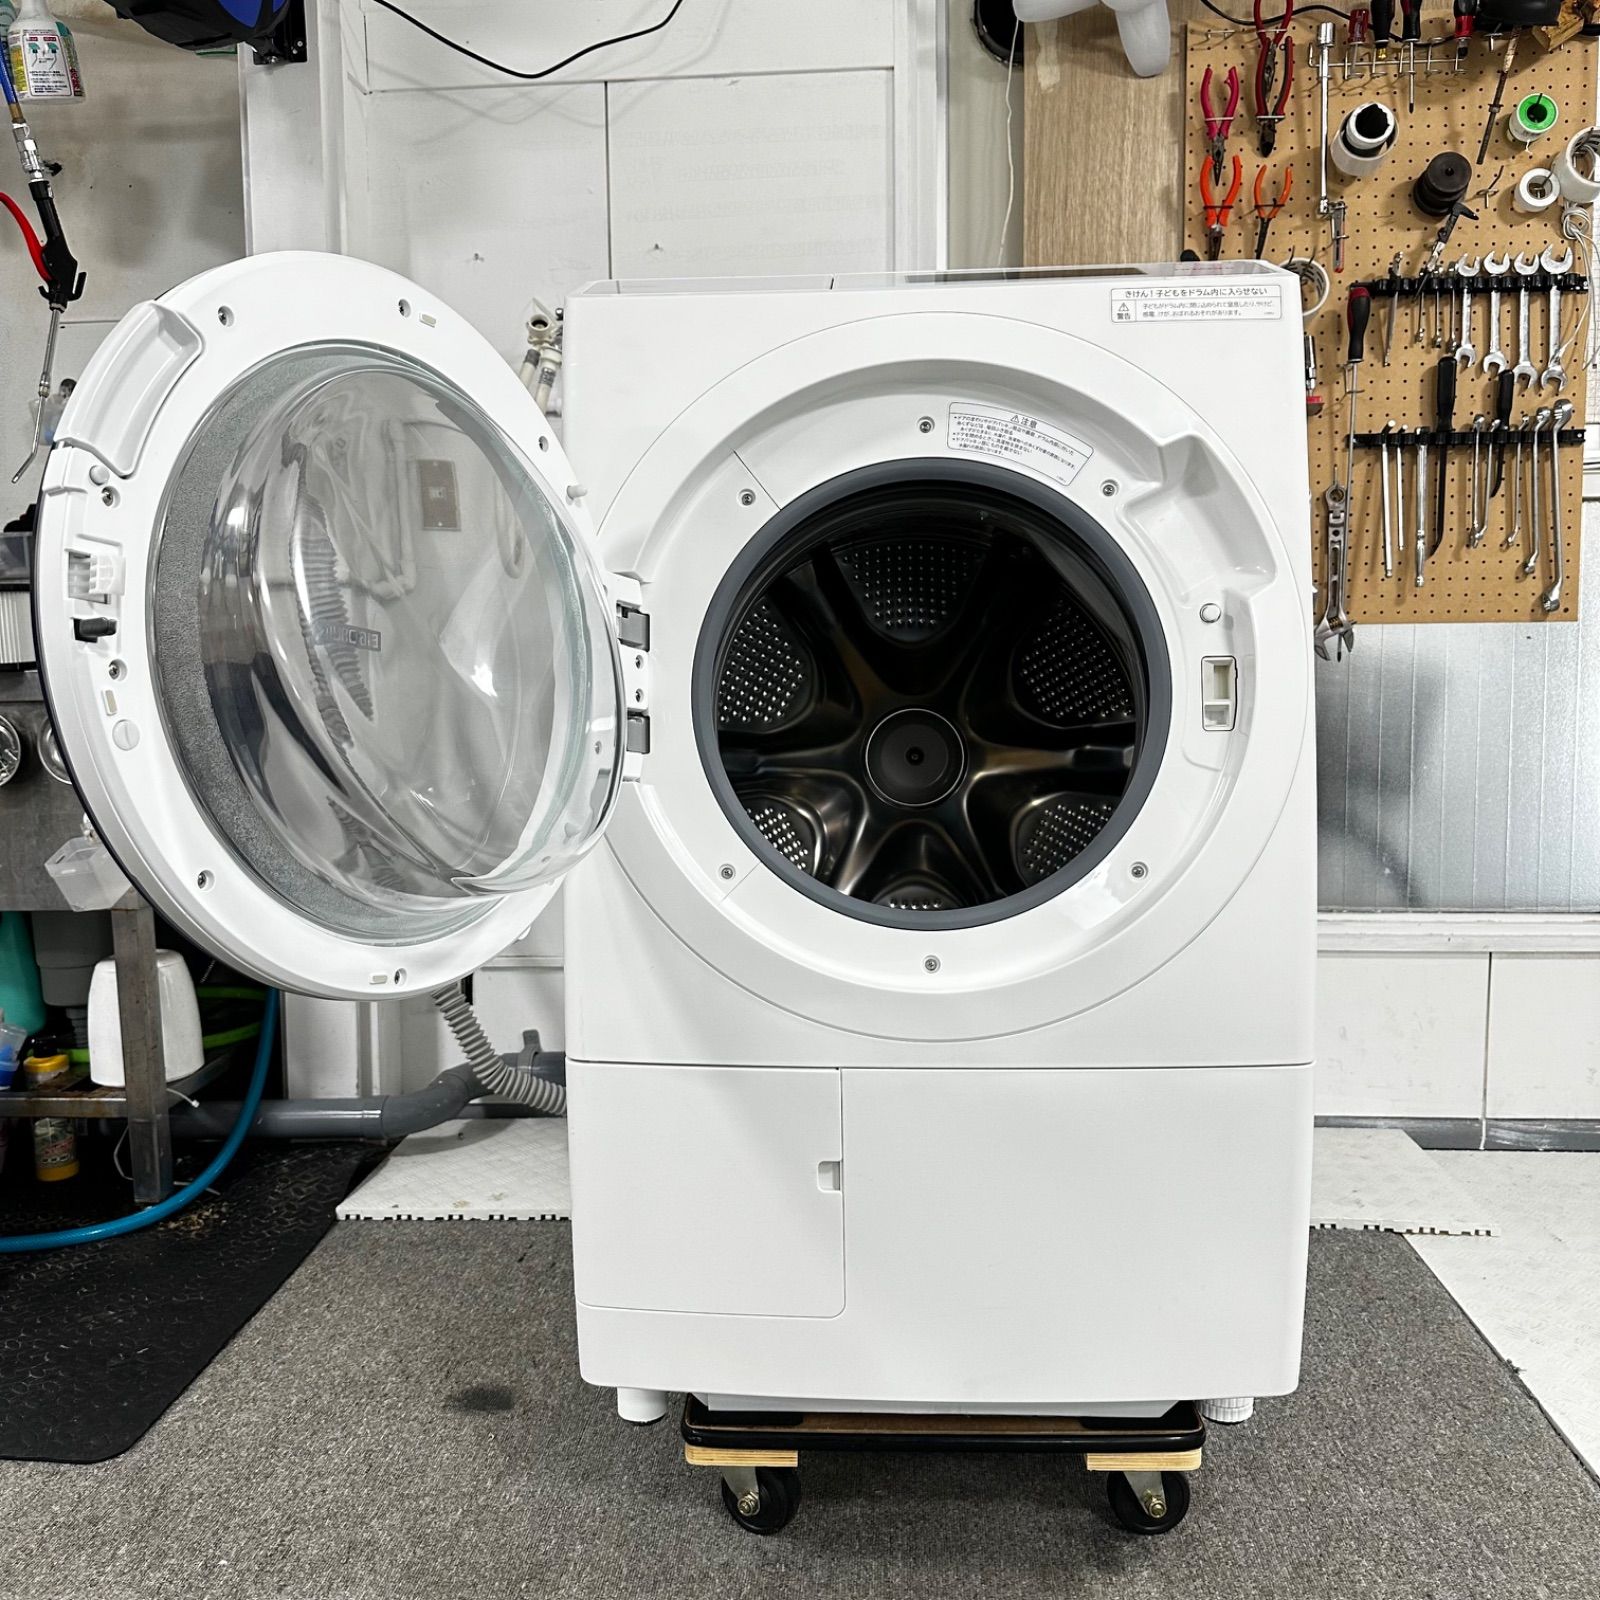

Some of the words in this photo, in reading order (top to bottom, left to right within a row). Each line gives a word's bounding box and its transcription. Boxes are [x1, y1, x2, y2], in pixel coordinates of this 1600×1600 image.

[1124, 287, 1268, 299] きけん！子どもをドラム内に入らせない
[1116, 312, 1131, 321] 警告
[1020, 416, 1038, 429] 注意
